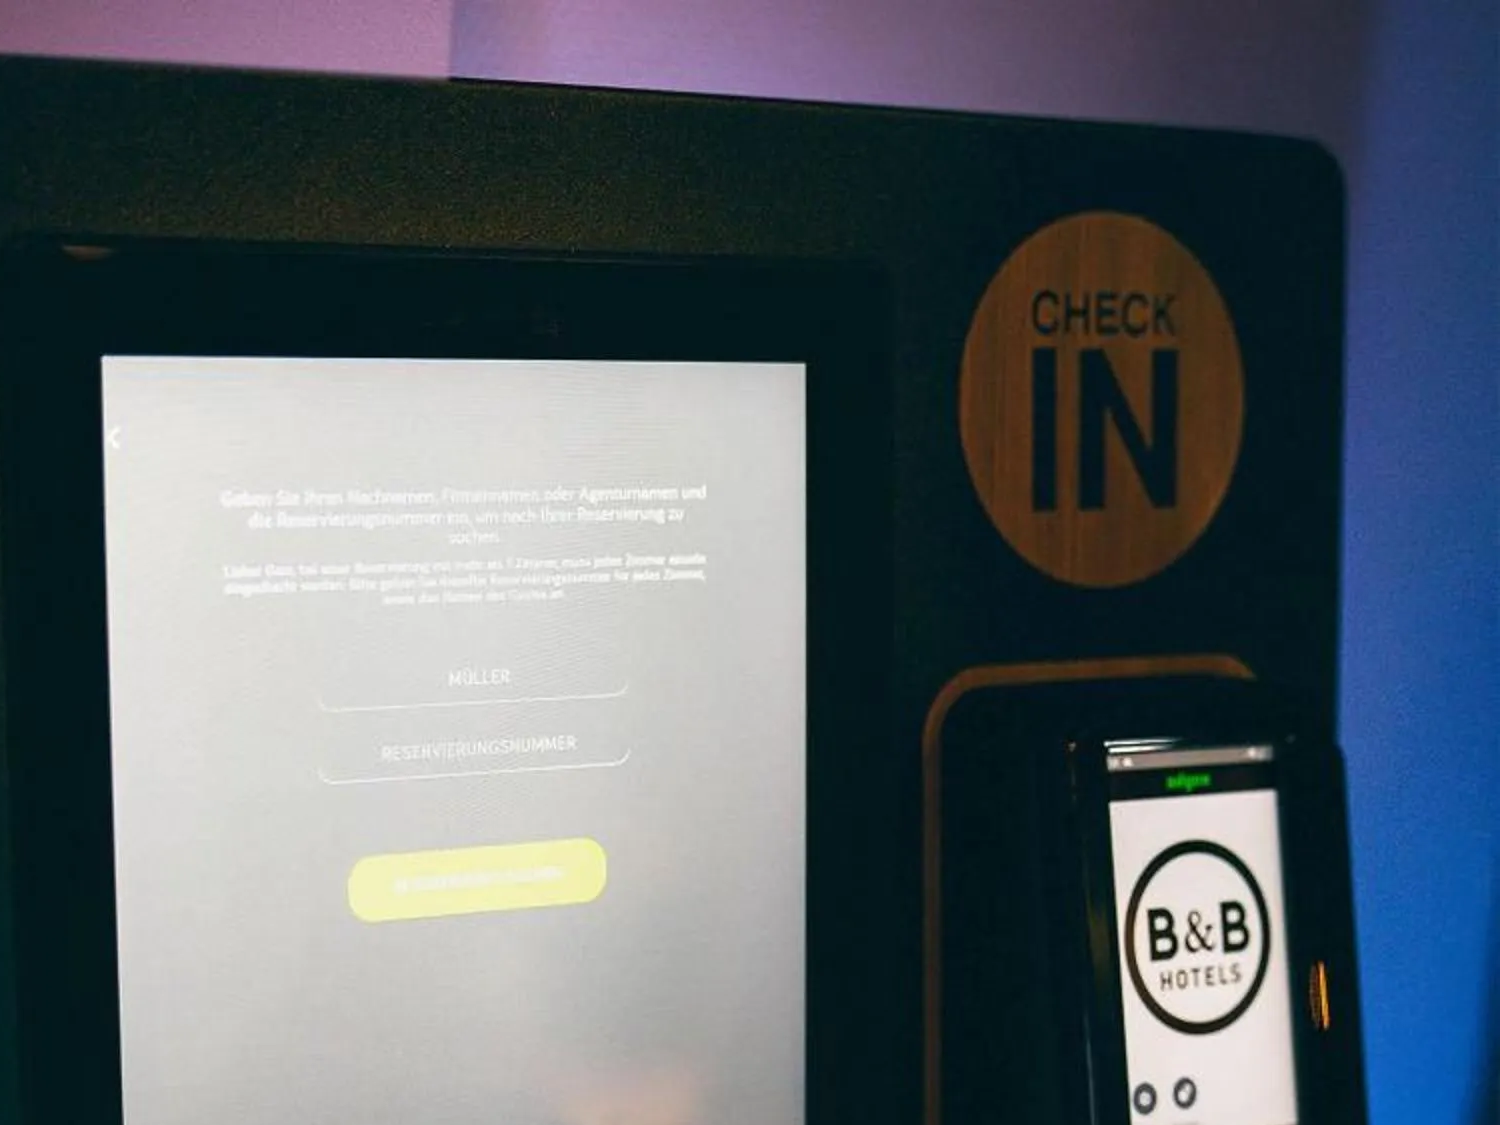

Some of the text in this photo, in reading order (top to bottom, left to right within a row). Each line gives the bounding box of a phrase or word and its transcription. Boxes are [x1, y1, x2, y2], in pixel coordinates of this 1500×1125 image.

[1031, 289, 1177, 338] CHECK
[1031, 346, 1179, 513] IN
[447, 665, 512, 687] MÜLLER
[380, 734, 579, 763] RESERVIERUNGSNUMMER
[1146, 900, 1251, 962] B&B
[1160, 963, 1244, 992] HOTELS
